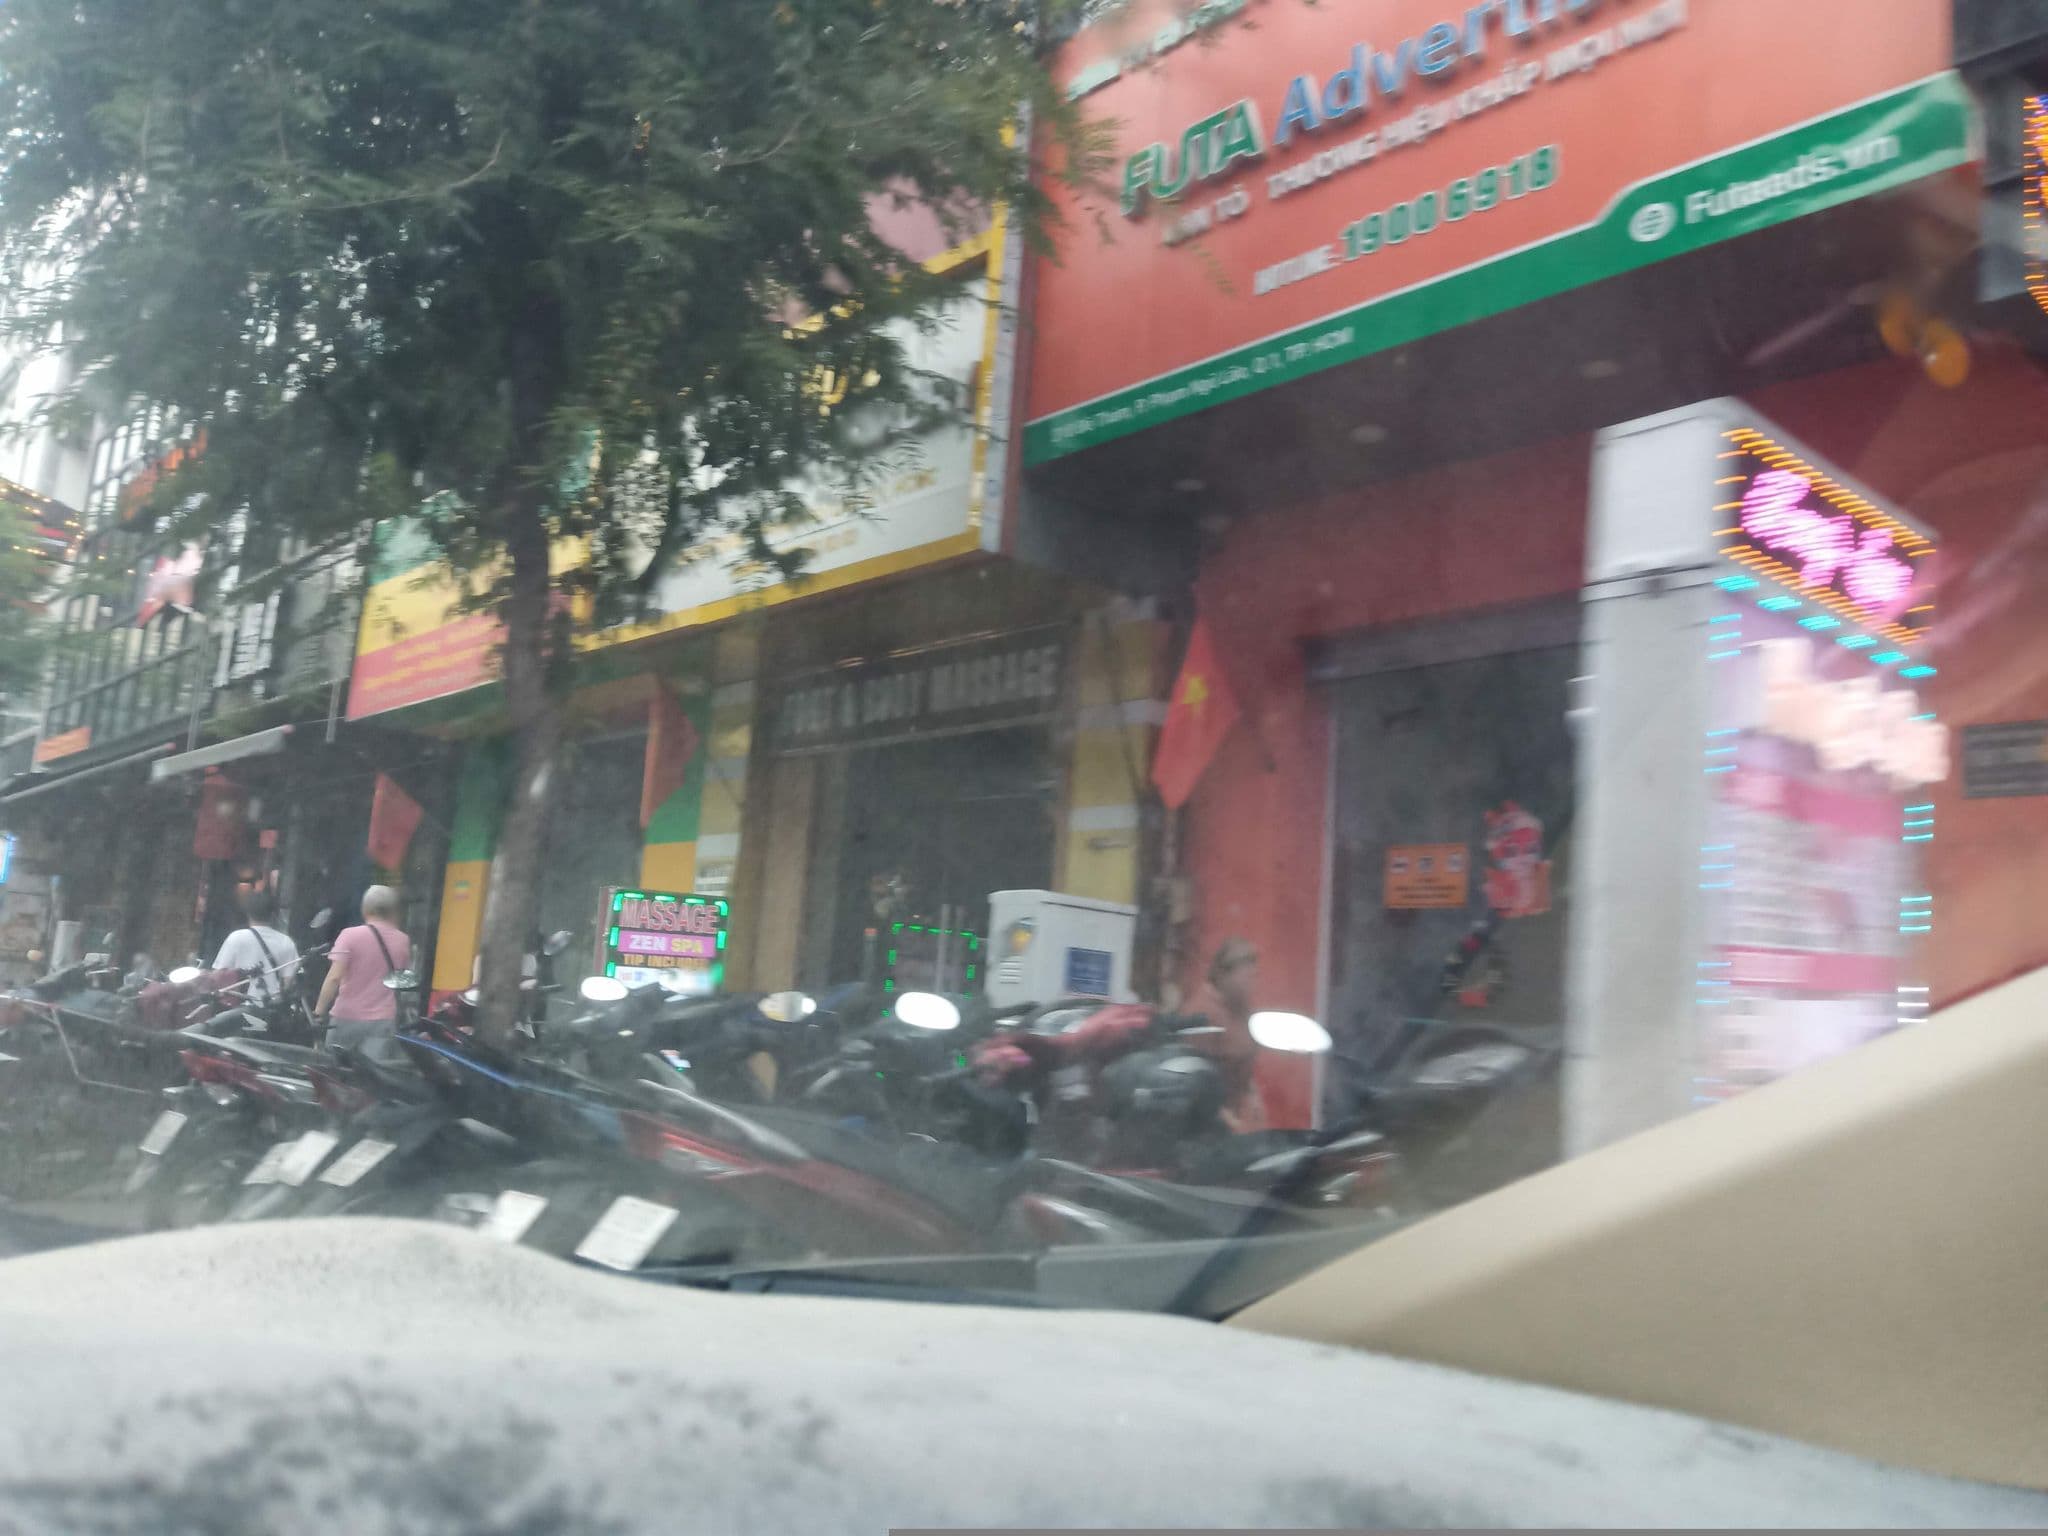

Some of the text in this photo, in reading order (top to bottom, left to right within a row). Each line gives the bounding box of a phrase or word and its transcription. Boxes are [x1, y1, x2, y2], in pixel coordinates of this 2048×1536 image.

[1120, 97, 1260, 216] FUTA
[1337, 190, 1443, 262] 1900
[1446, 143, 1560, 222] 6918
[619, 899, 718, 934] MASSAGE
[629, 934, 703, 954] ZEN SPA
